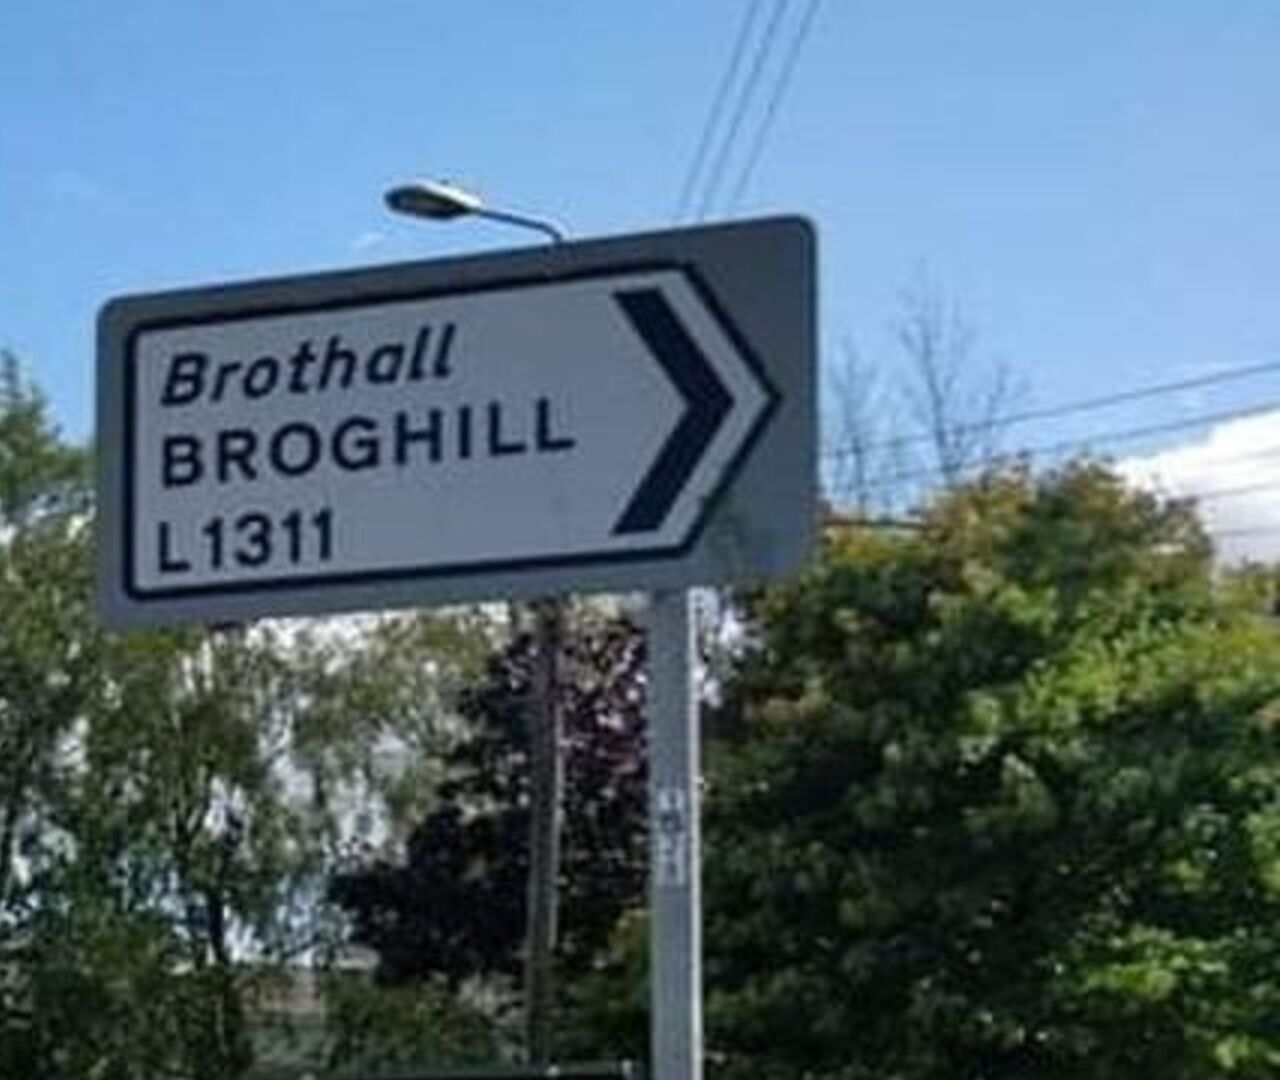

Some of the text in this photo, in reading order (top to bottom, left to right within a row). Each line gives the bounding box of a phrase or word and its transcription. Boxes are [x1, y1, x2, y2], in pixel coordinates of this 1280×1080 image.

[161, 322, 457, 406] Brothall
[162, 399, 576, 488] BROGHILL
[158, 508, 334, 574] L1311
